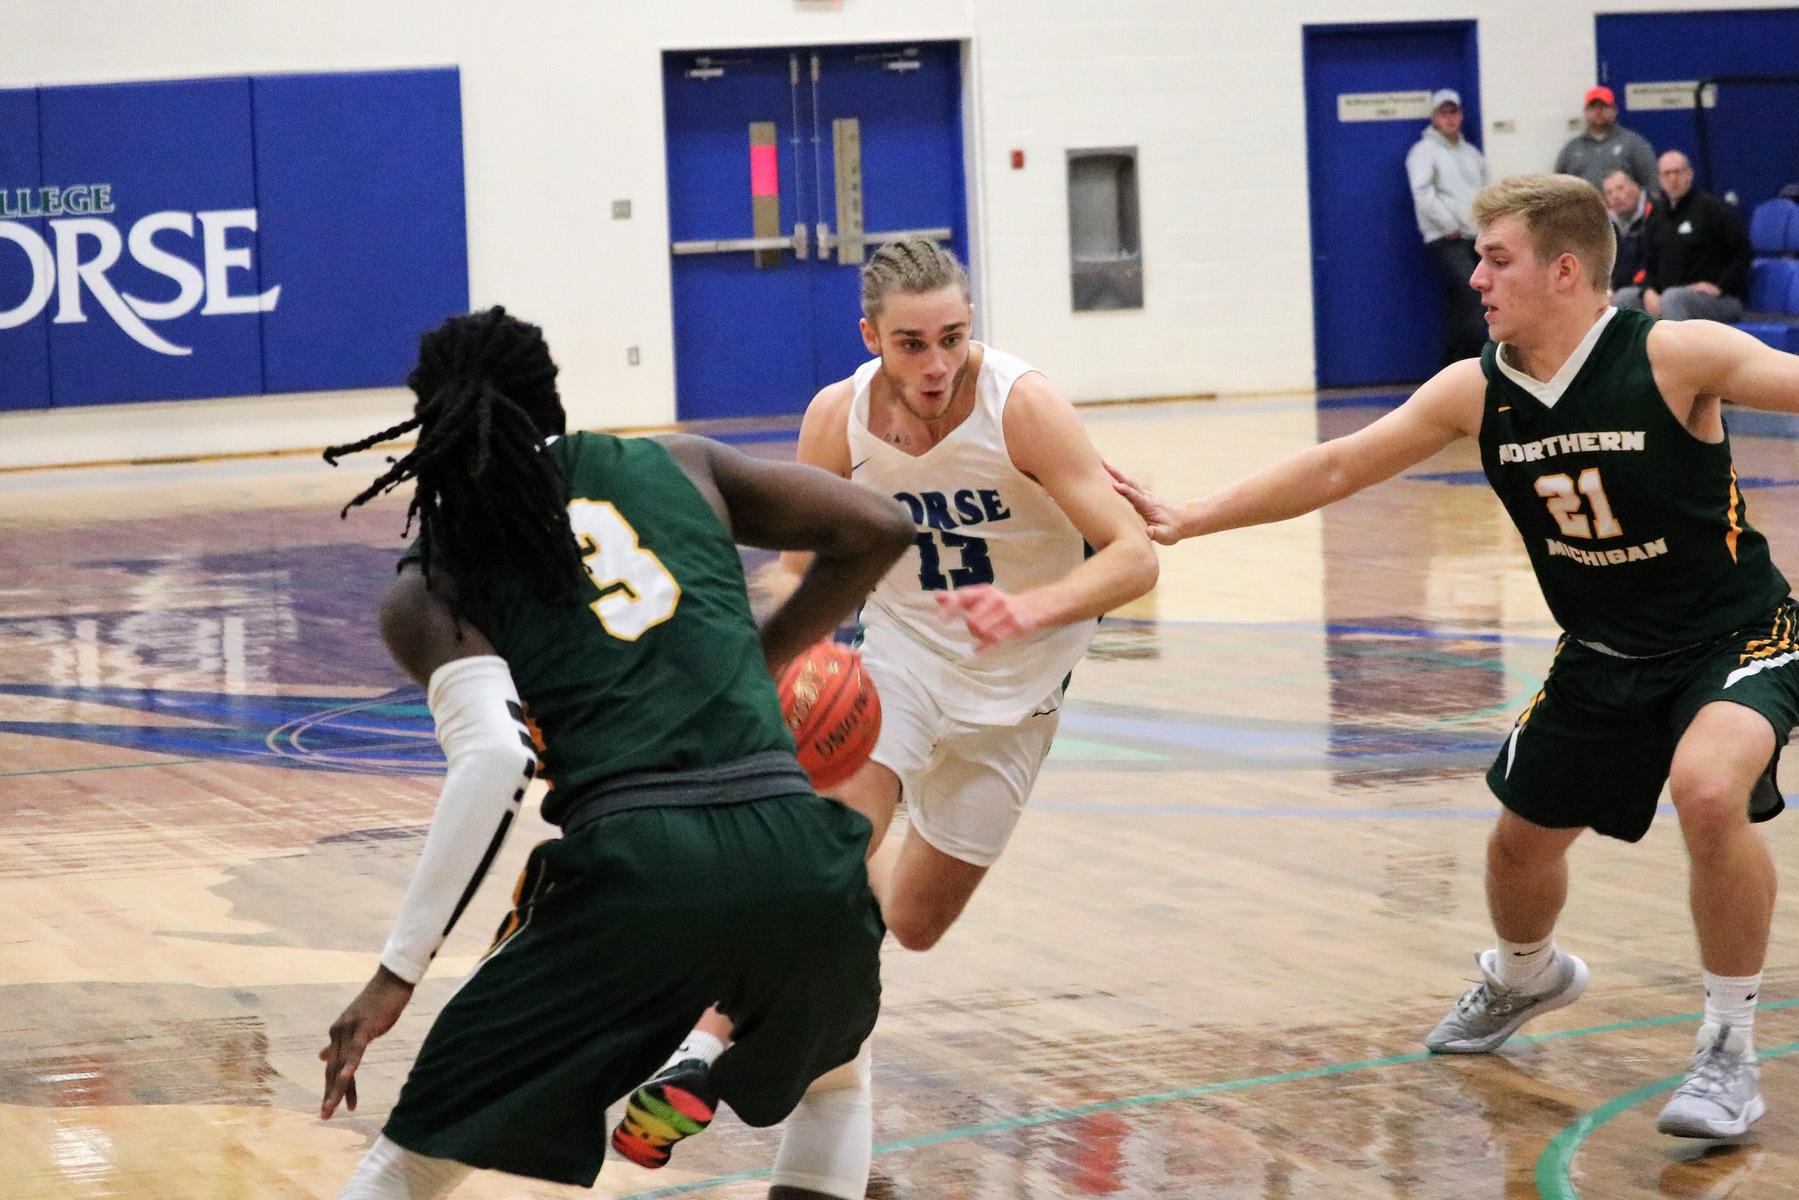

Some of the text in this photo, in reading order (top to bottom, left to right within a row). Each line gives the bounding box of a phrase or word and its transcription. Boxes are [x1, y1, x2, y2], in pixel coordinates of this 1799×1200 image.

[1498, 430, 1647, 466] NORTHERN
[1534, 467, 1624, 540] 21
[565, 497, 683, 642] 3
[917, 531, 995, 592] 13
[1545, 536, 1670, 567] MICHIGAN
